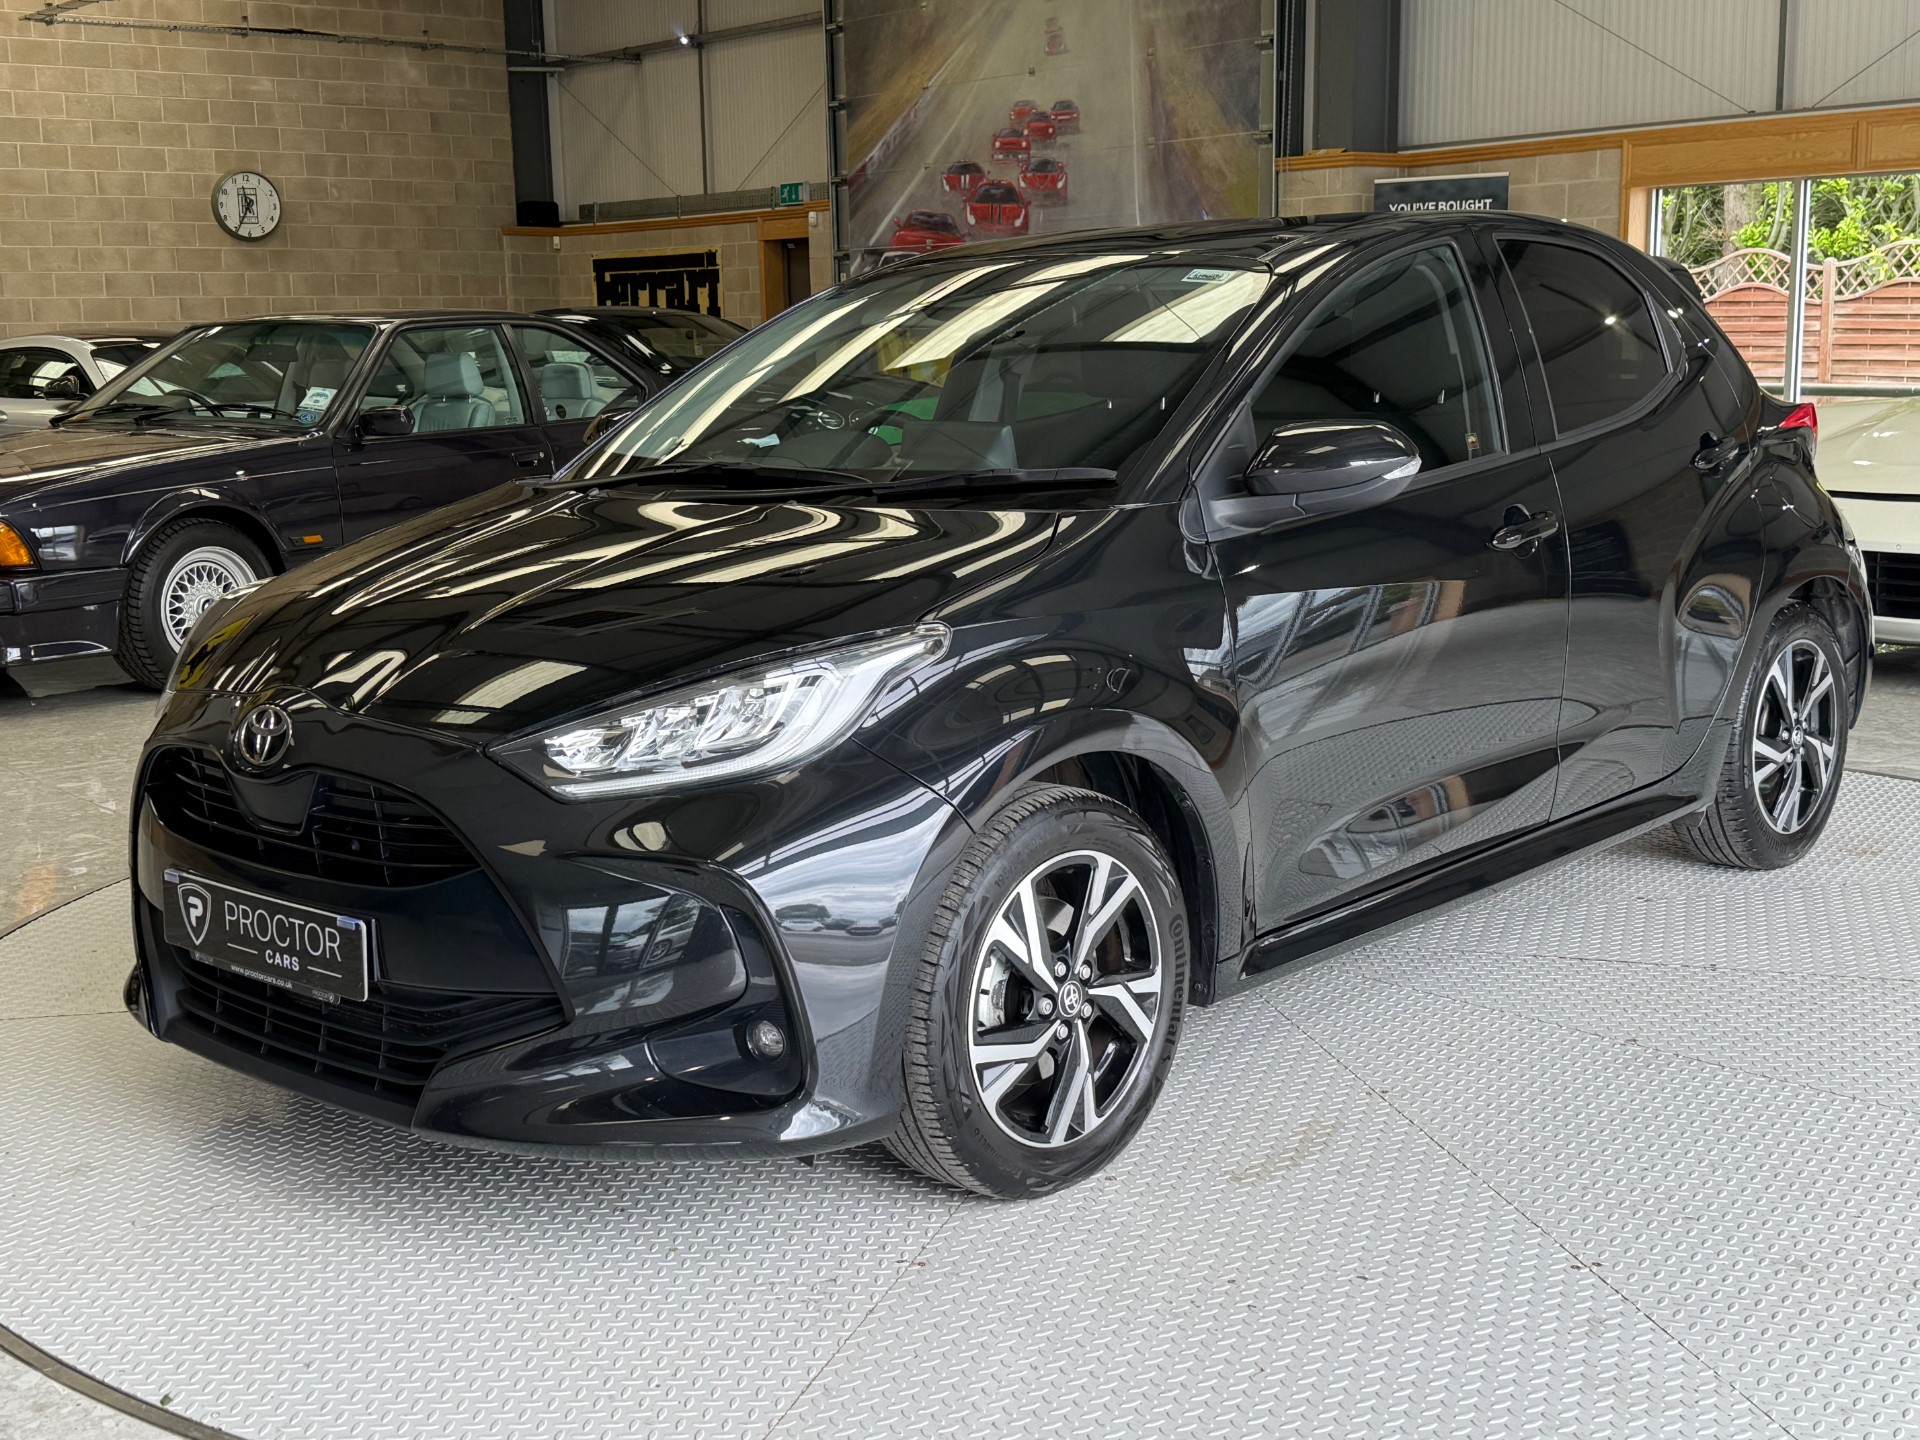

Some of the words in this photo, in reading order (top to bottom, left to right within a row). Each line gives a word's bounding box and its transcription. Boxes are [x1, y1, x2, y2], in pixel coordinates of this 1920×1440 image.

[1438, 198, 1493, 211] BOUGHT
[224, 900, 342, 962] PROCTOR
[265, 949, 300, 972] CARS
[230, 964, 293, 989] www.proctorcars.co.uk
[1165, 913, 1188, 1046] Continental
